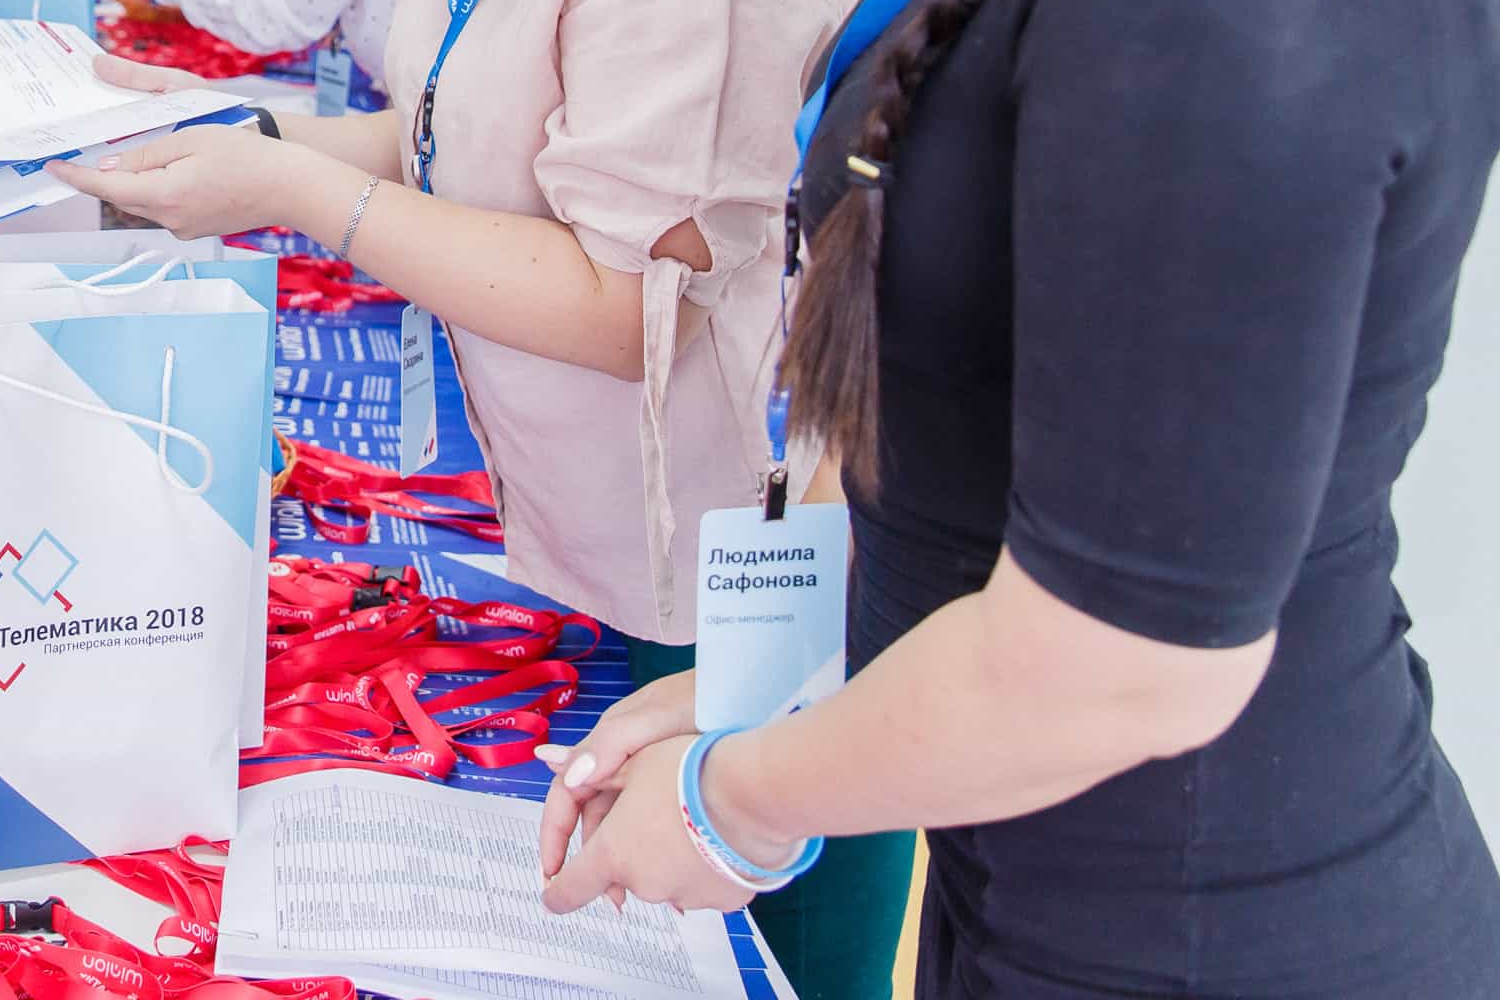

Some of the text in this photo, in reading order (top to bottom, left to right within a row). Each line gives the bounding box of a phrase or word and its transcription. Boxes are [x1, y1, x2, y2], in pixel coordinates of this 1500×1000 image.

[708, 547, 815, 565] Людмила
[707, 573, 817, 593] Сафонова
[146, 606, 204, 630] 2018
[485, 605, 535, 626] wialon
[44, 630, 204, 654] Партнерская конференция
[83, 953, 143, 989] wialon
